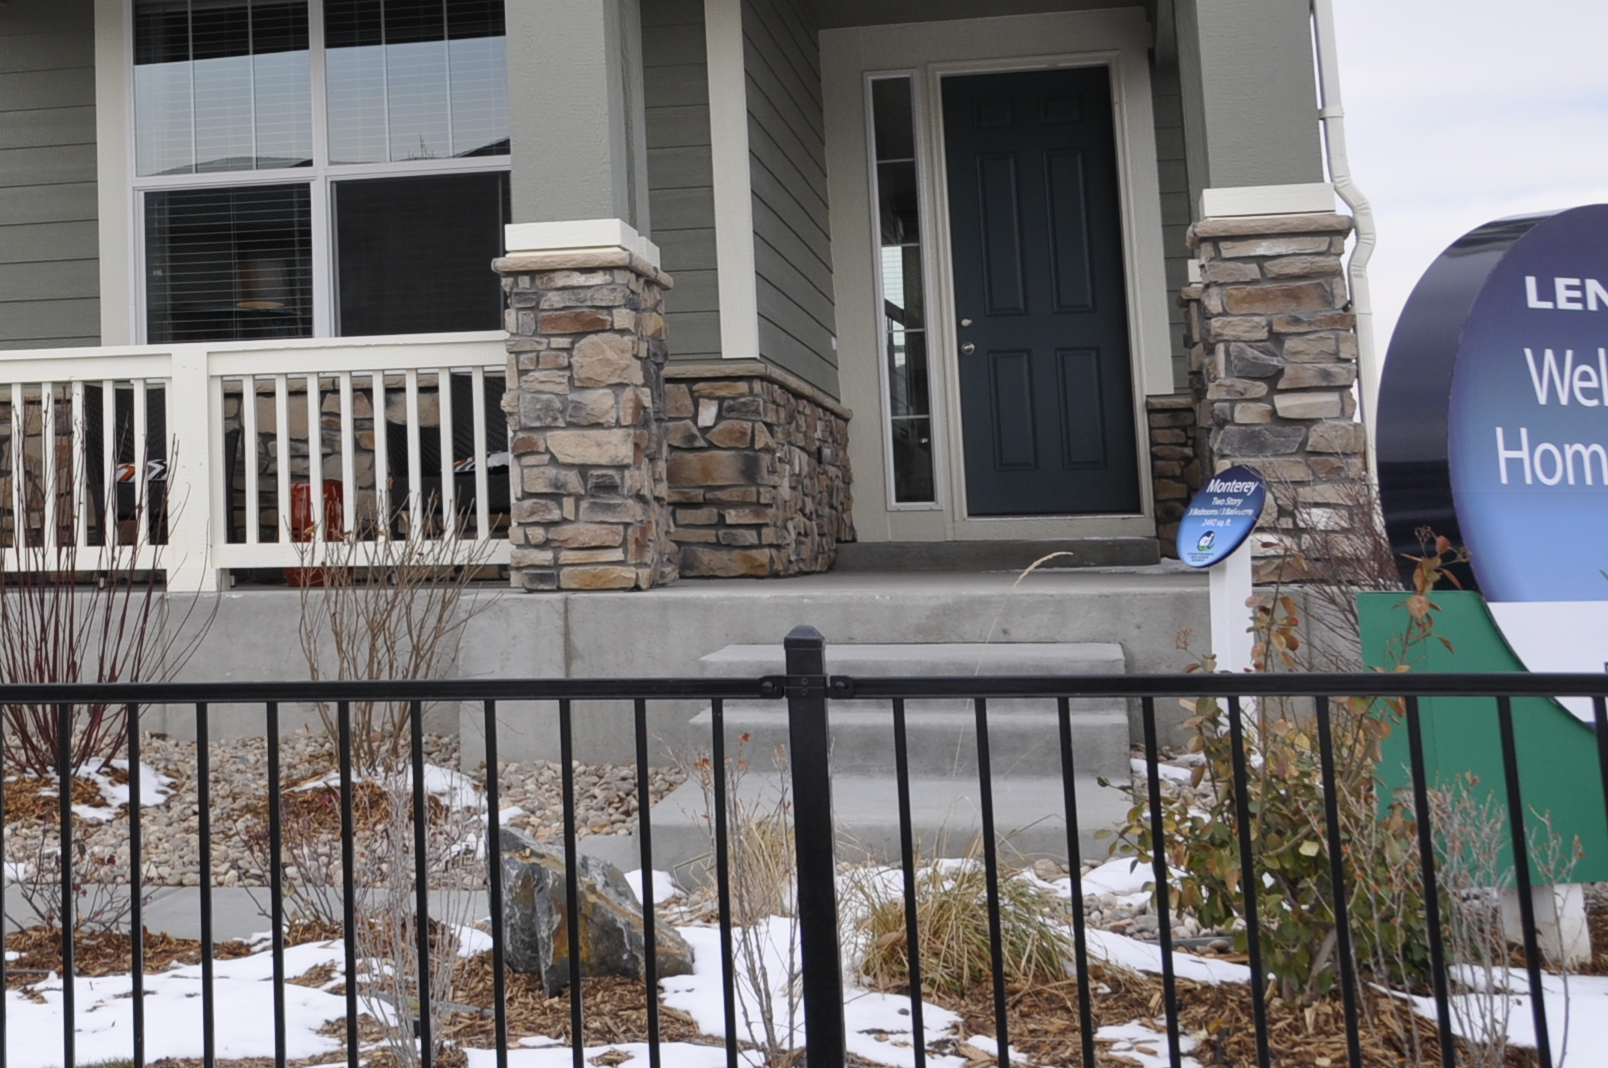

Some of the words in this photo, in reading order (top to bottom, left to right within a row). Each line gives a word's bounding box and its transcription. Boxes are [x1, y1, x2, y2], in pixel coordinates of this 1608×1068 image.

[1523, 347, 1608, 407] Wel
[1495, 426, 1608, 486] Hom
[1205, 478, 1259, 496] Monterey
[1211, 497, 1225, 505] Two
[1225, 497, 1243, 507] Story
